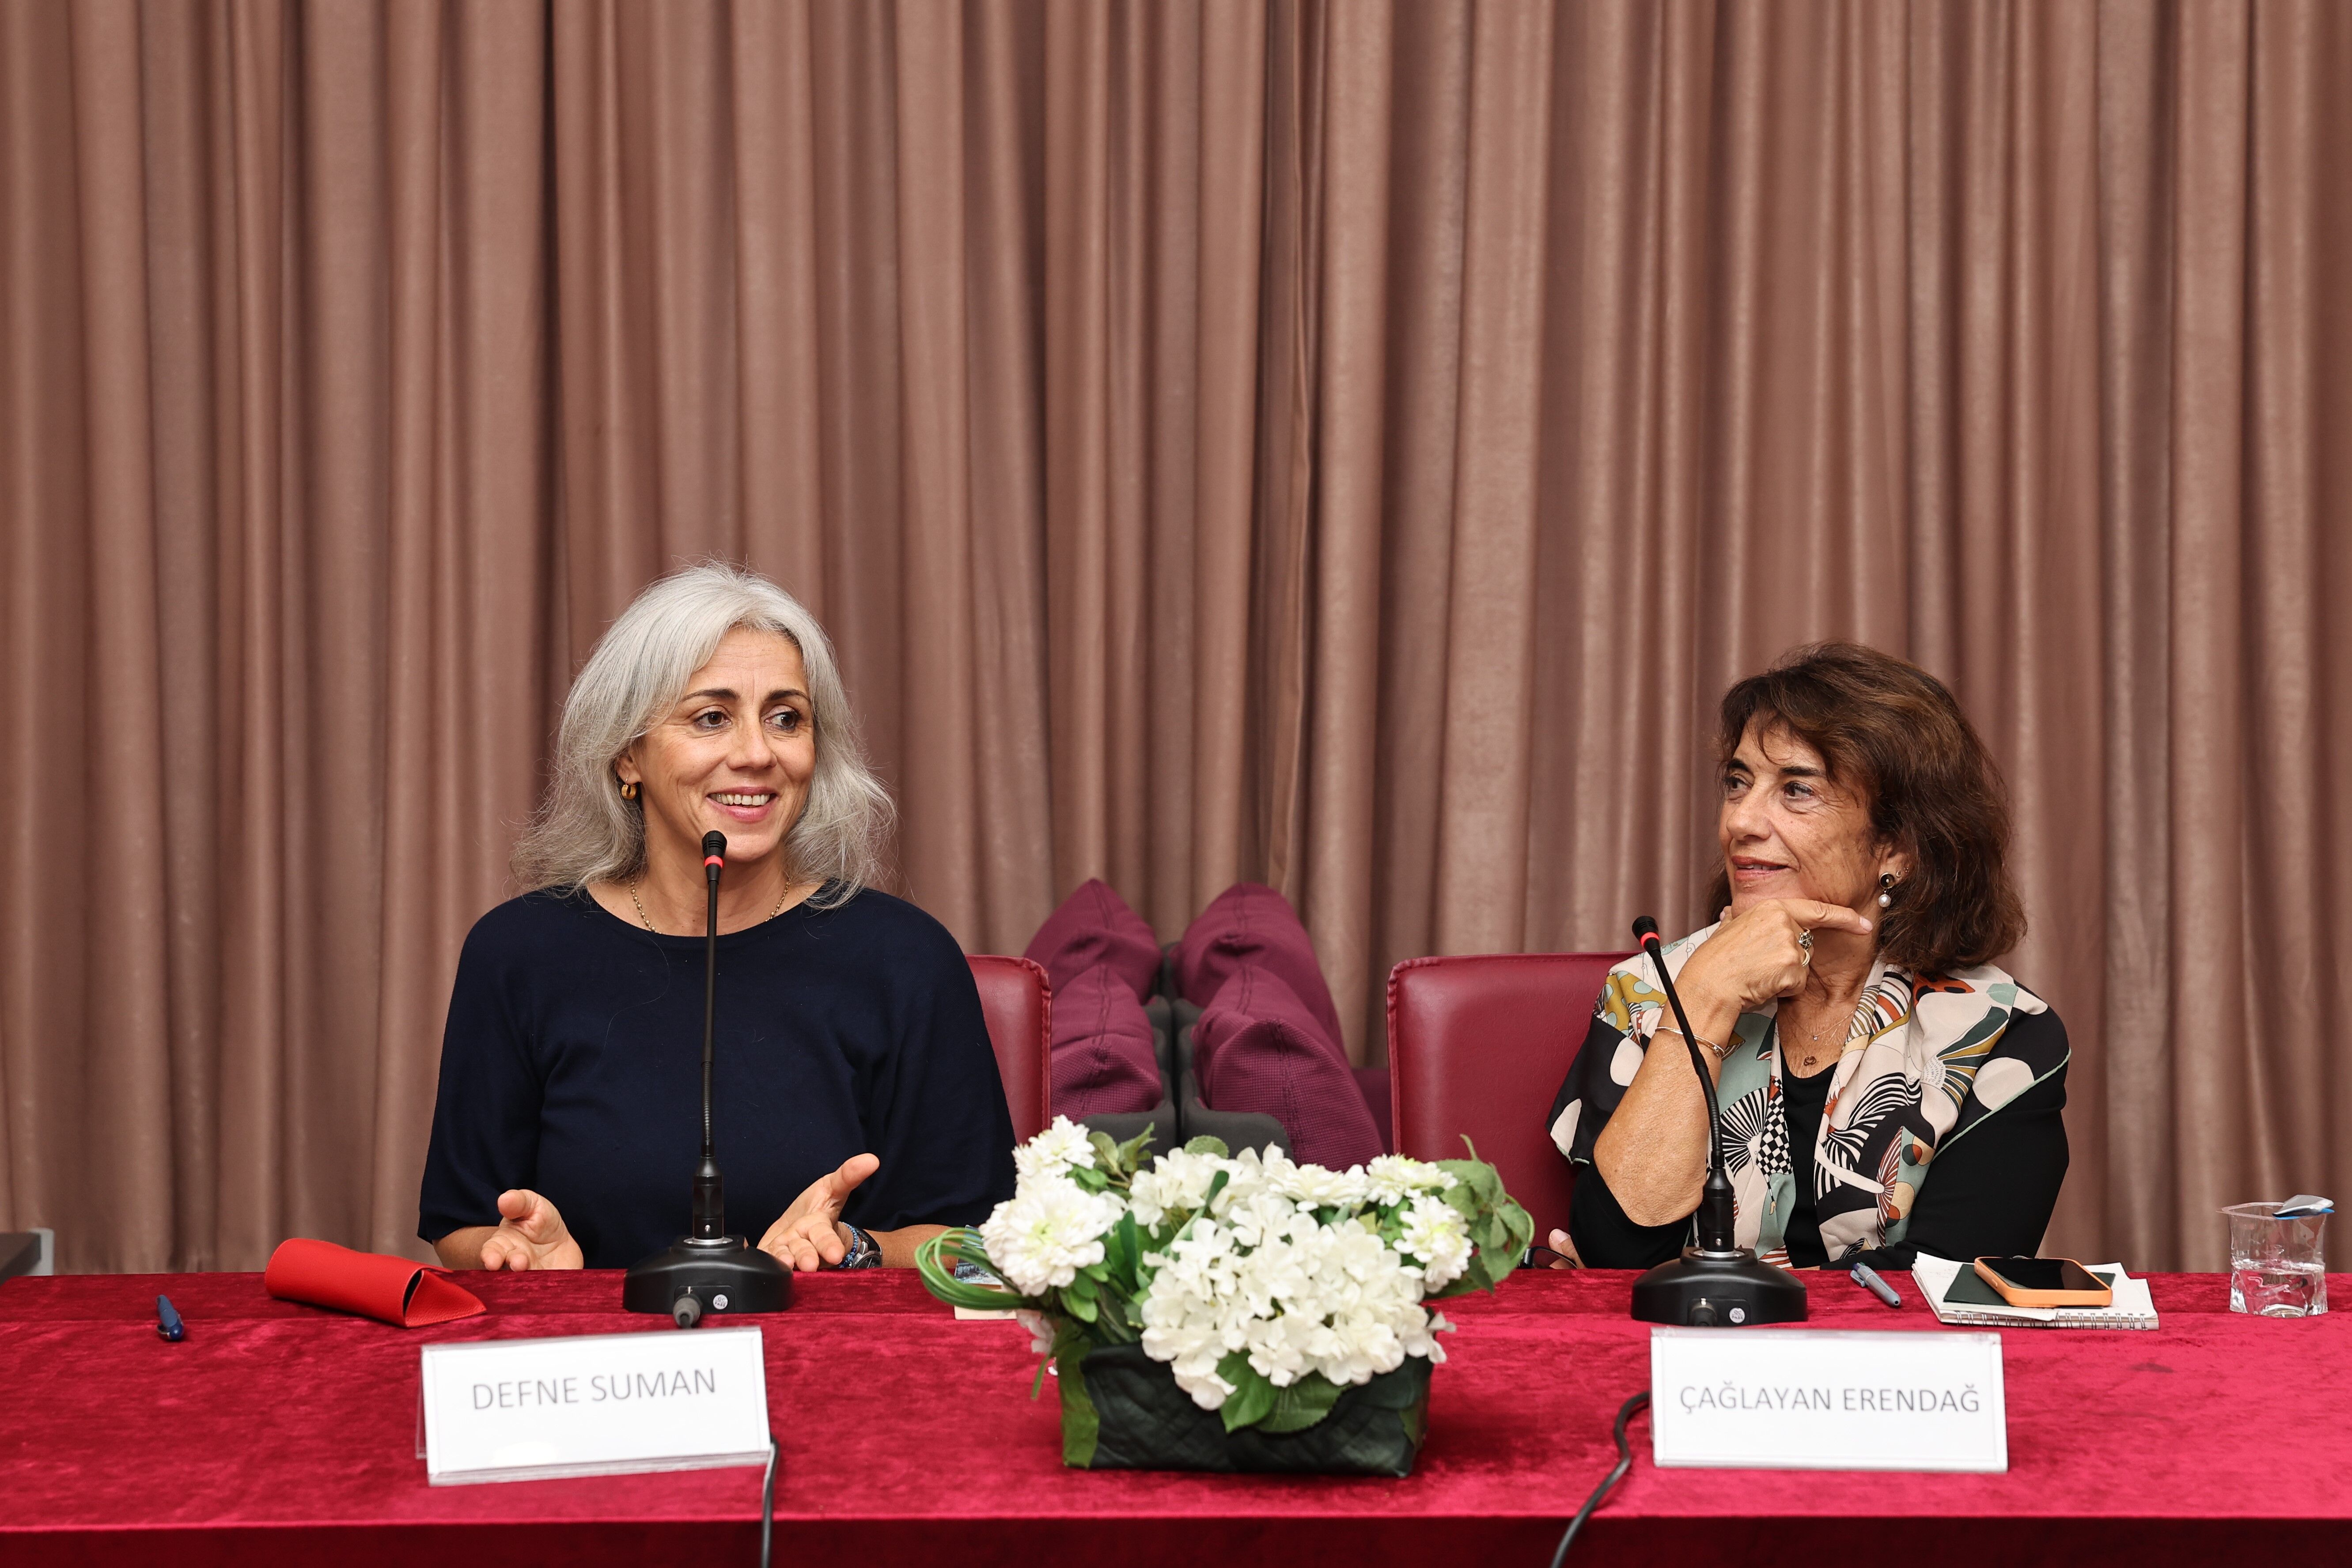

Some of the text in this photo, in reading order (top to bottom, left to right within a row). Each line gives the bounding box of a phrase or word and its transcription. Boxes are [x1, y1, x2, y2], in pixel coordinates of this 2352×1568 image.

[473, 1368, 716, 1410] DEFNE SUMAN
[1680, 1381, 1979, 1414] ÇAĞLAYAN ERENDAĞ
